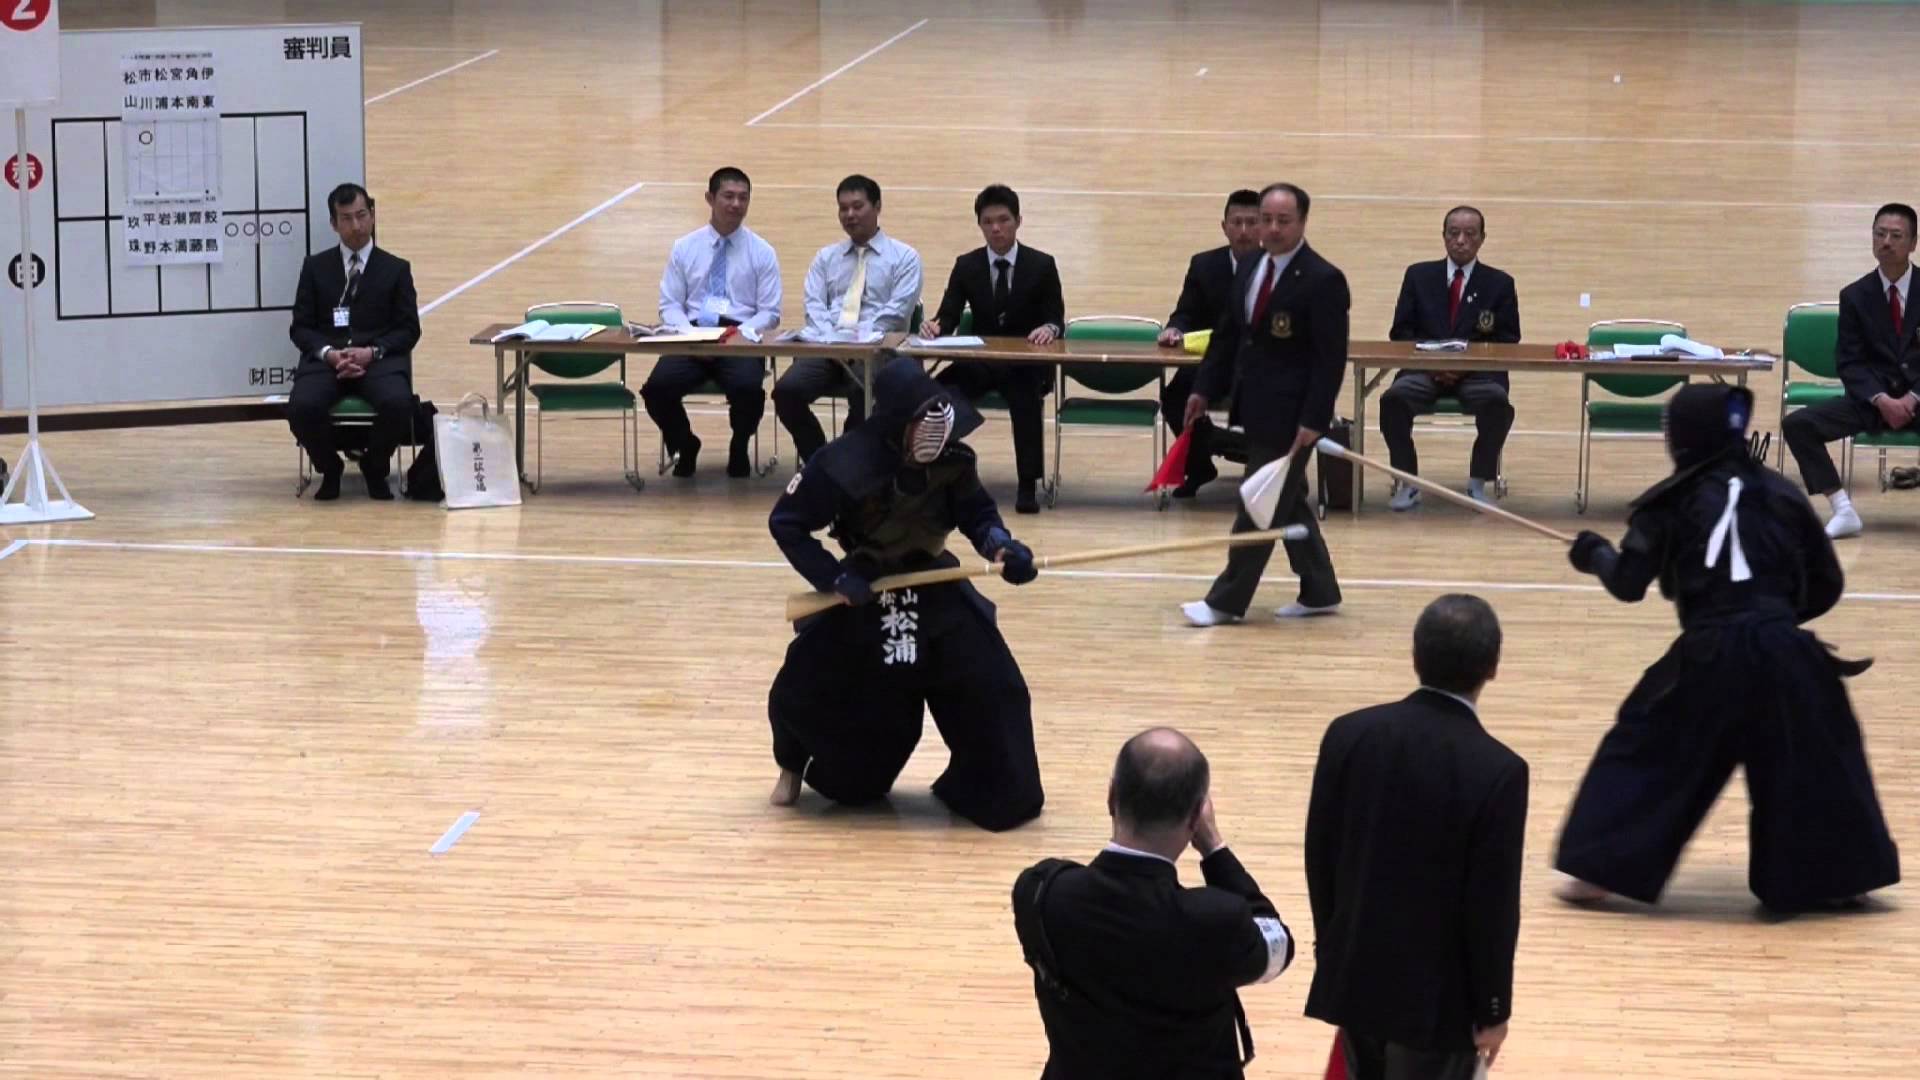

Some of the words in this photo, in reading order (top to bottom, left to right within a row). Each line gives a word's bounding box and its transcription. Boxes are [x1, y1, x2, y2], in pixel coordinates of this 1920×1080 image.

[283, 36, 352, 60] 審判員
[879, 605, 920, 665] 松浦
